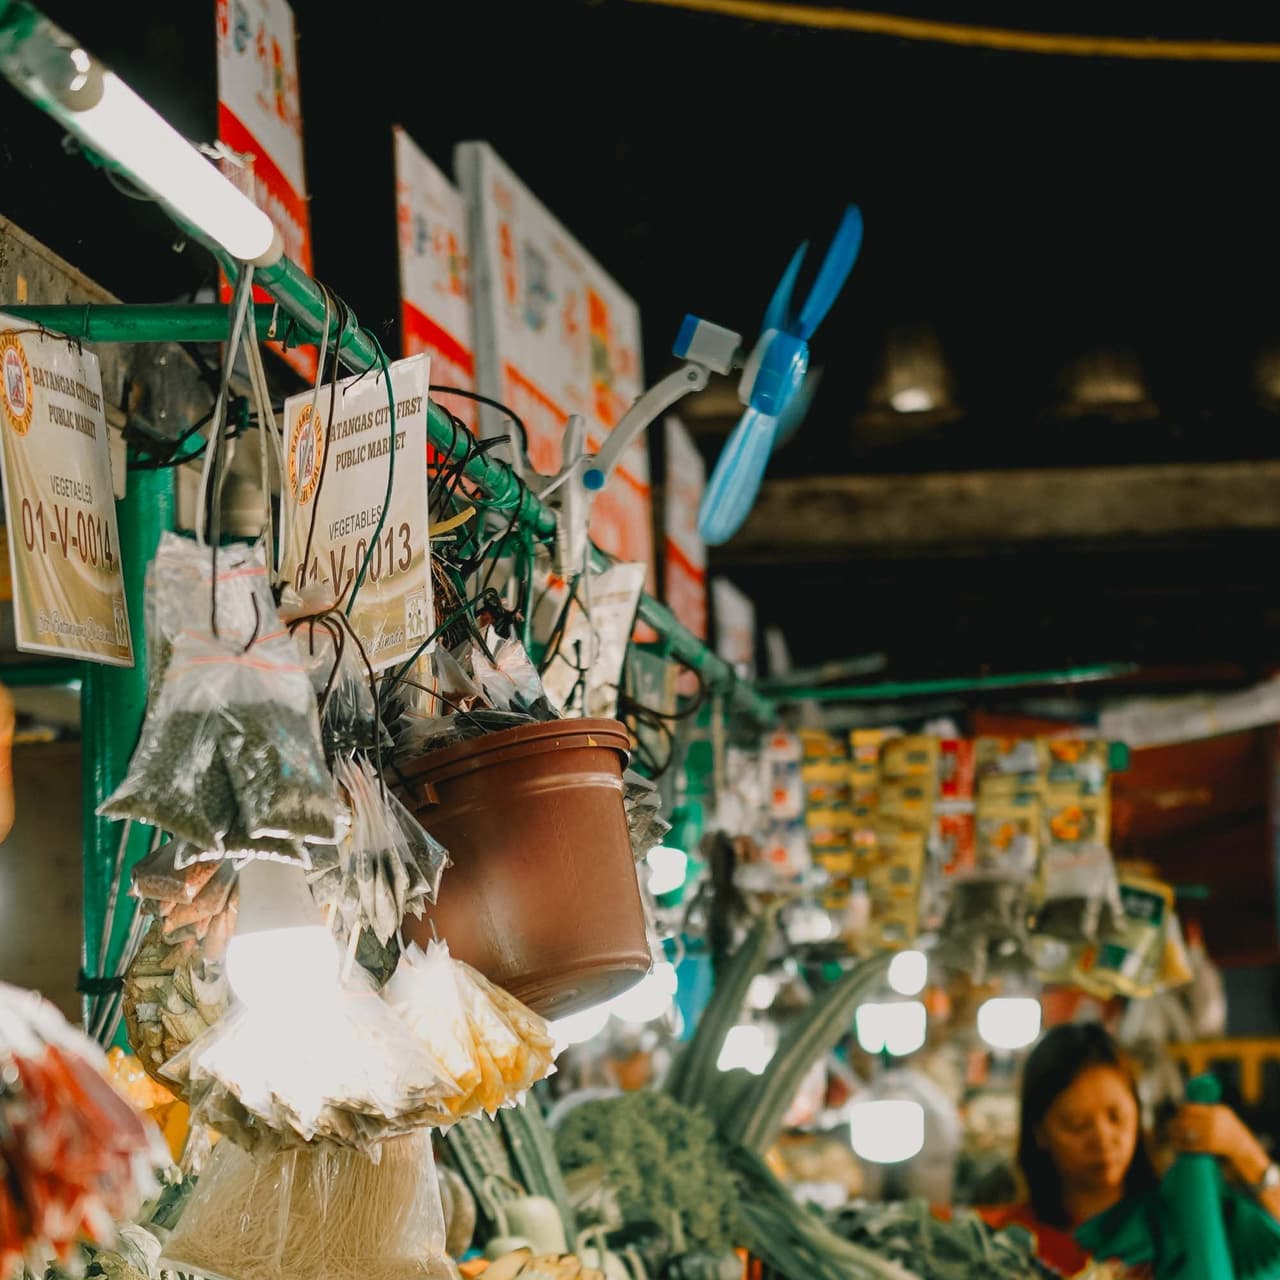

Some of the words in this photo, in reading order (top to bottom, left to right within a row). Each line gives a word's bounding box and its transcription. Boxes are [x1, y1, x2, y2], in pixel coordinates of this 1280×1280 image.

[32, 367, 76, 398] BATANGAS
[48, 403, 75, 430] PUBLIC
[327, 409, 374, 442] ATANGAS
[374, 403, 395, 427] CIT
[396, 397, 423, 420] FIRST
[335, 446, 366, 472] PUBLIC
[50, 474, 94, 505] VEGETABLES
[22, 497, 113, 571] 01-V-0014
[328, 505, 382, 541] VEGETABLES
